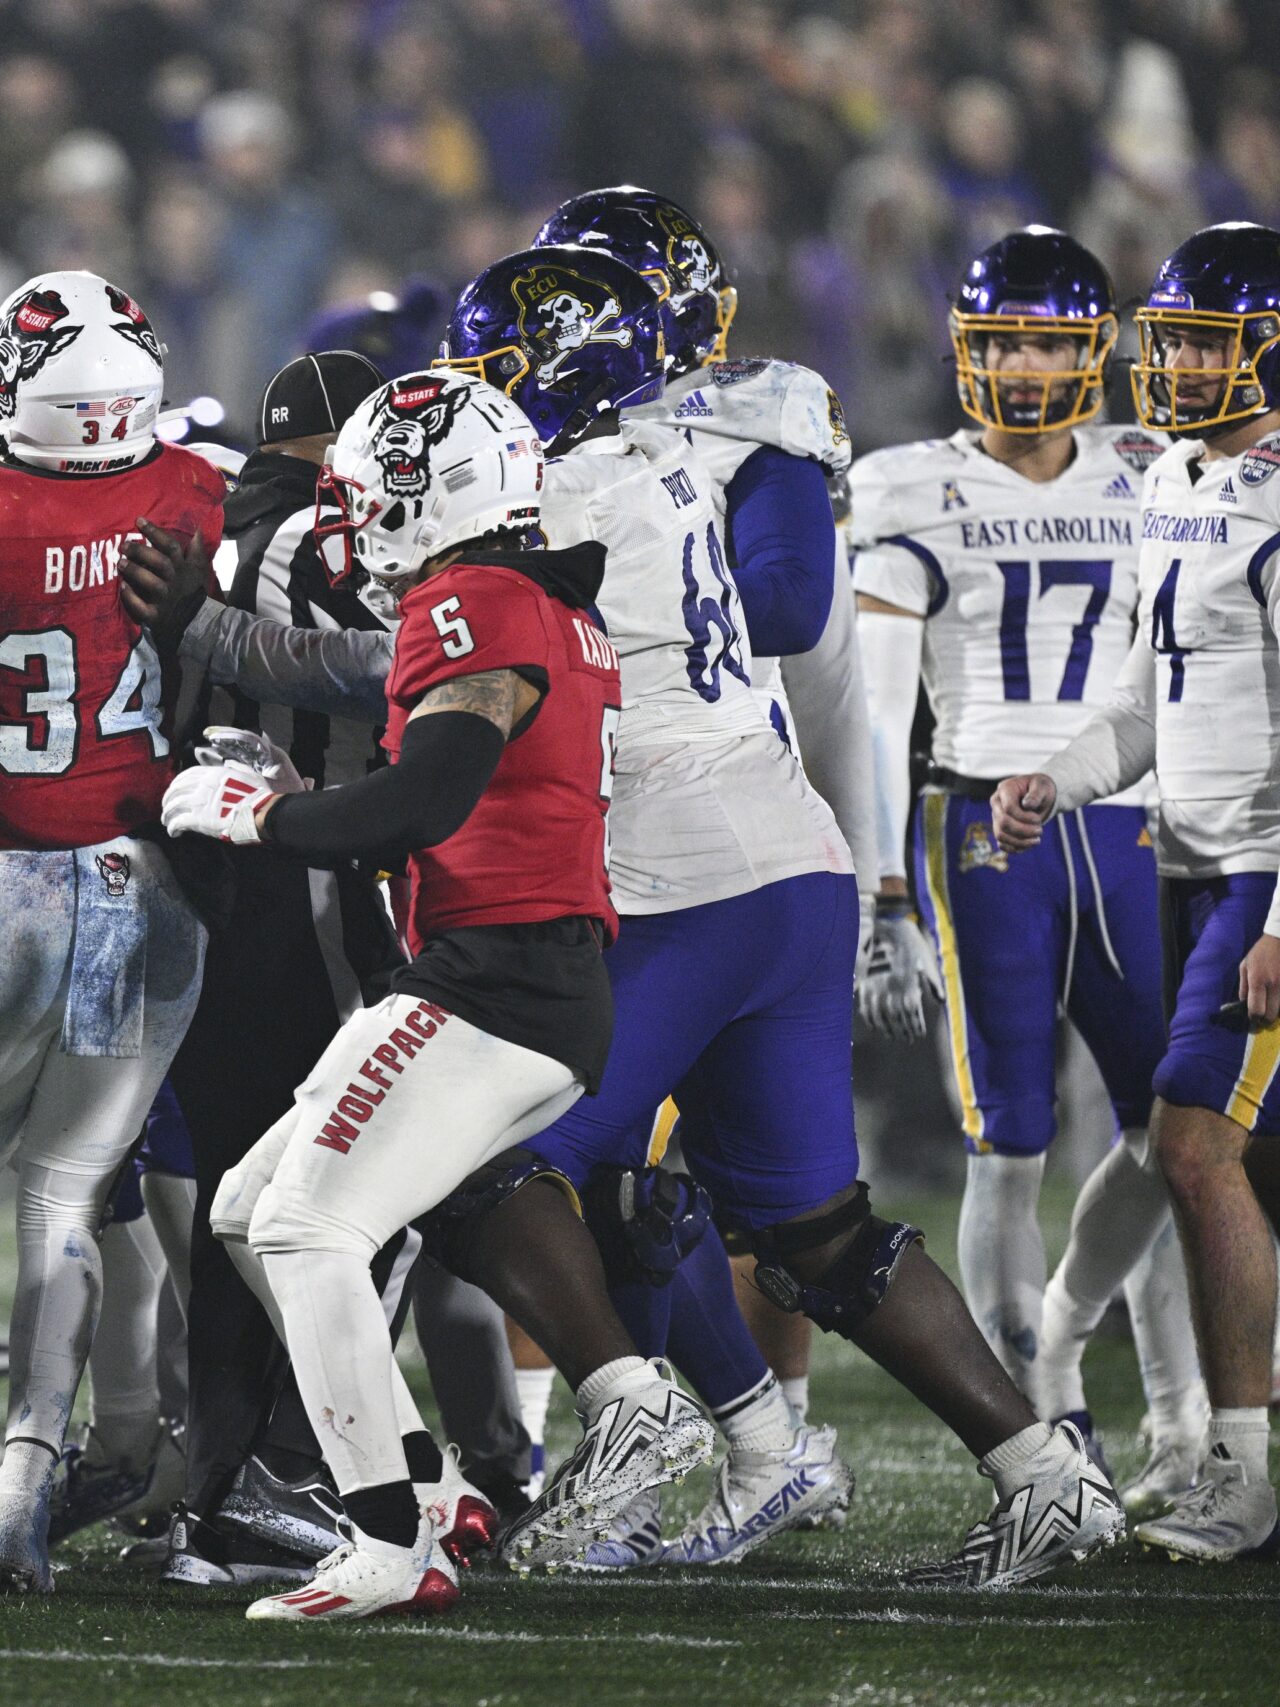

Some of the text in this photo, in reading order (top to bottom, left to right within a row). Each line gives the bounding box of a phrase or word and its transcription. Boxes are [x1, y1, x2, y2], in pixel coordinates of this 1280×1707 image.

[526, 273, 559, 301] ECU
[18, 307, 52, 329] NC STATE
[114, 399, 133, 410] ACC
[393, 388, 435, 405] NC STATE
[271, 406, 289, 424] RR
[674, 404, 714, 418] adidas
[534, 462, 544, 492] 5
[961, 515, 1133, 549] EAST CAROLINA
[1163, 516, 1228, 545] CAROLINA
[429, 593, 476, 660] 5
[995, 560, 1114, 703] 17
[1151, 558, 1192, 703] 4
[313, 1000, 454, 1156] WOLFPACK
[889, 1223, 914, 1250] DONJO
[175, 1526, 185, 1546] AIR
